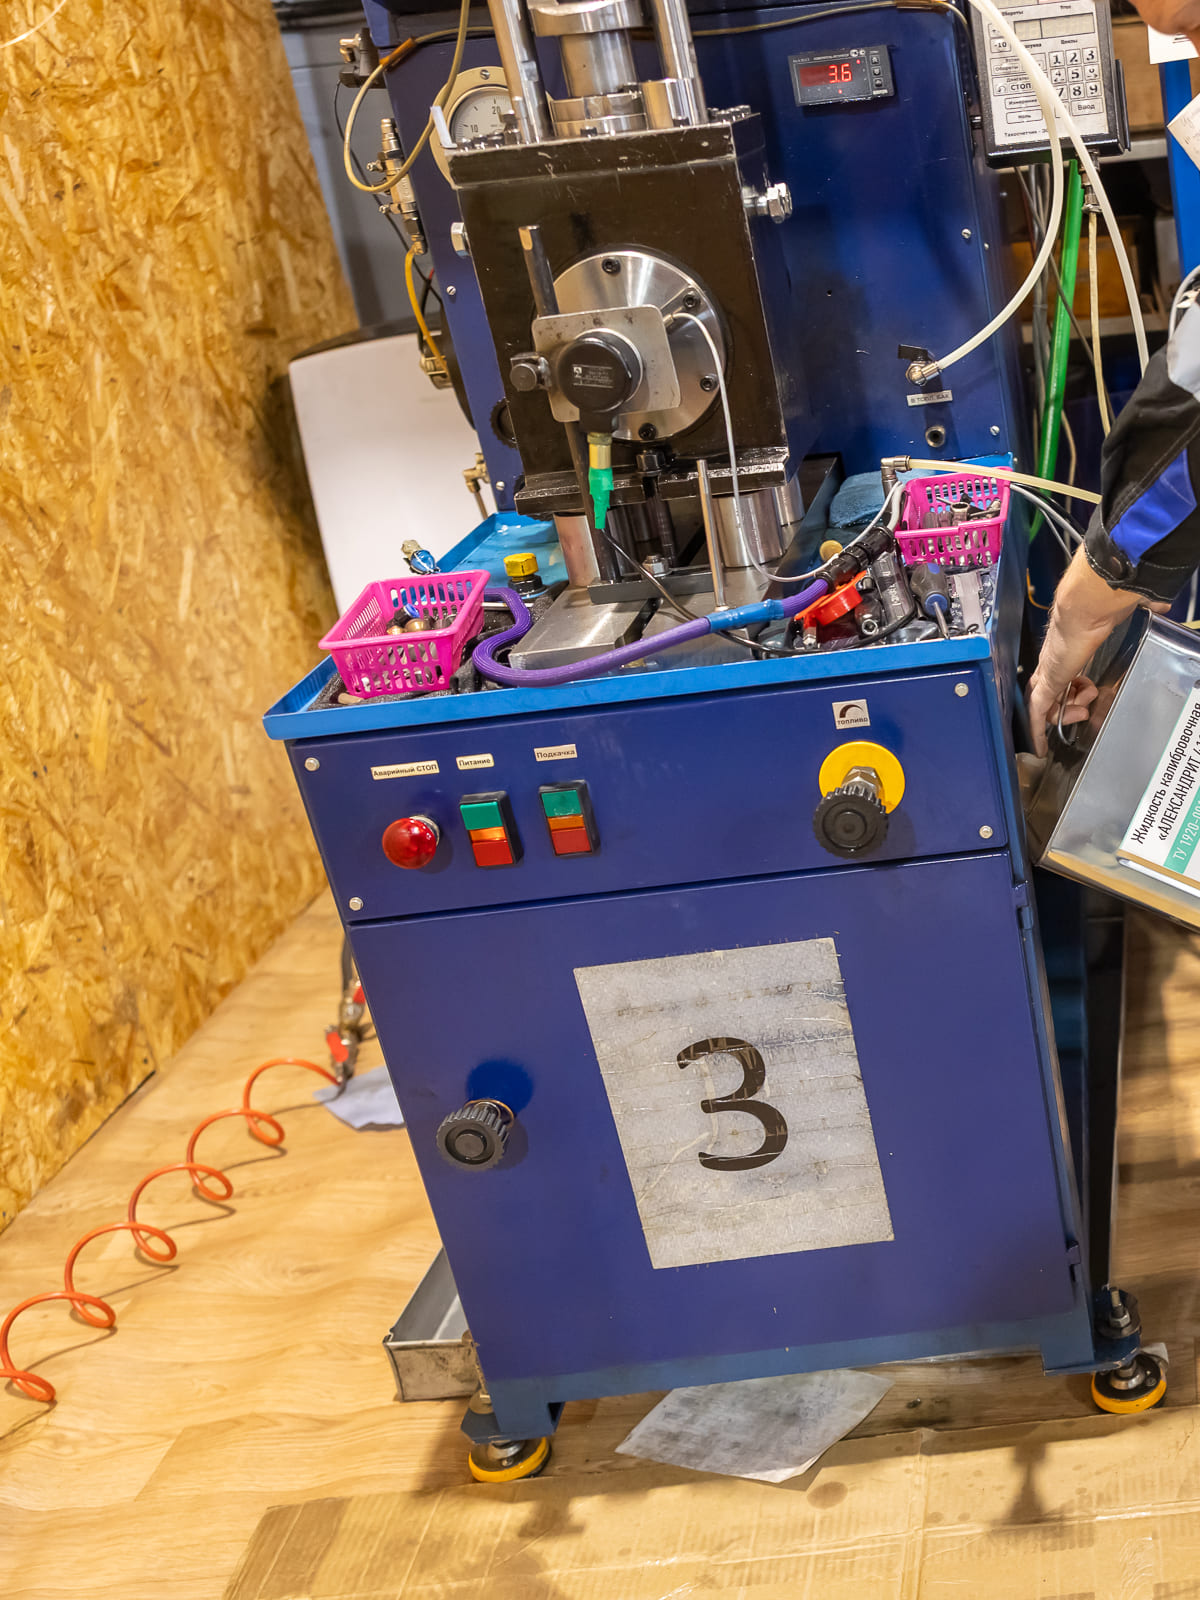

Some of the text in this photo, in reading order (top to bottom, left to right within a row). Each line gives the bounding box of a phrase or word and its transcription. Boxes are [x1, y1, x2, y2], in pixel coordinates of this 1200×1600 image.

[1053, 50, 1095, 65] 1 2 3
[829, 63, 852, 84] 3.6
[1071, 69, 1080, 80] 5
[1057, 84, 1098, 97] 7 8 9
[492, 105, 501, 115] 20
[470, 124, 479, 133] 10
[536, 750, 575, 758] Подкачка
[459, 758, 491, 766] Питание
[373, 767, 415, 776] Аварийный
[1157, 755, 1200, 840] «АЛЕКСАНДРИТ
[1130, 789, 1166, 844] Жидкость
[1172, 846, 1186, 860] ТУ
[676, 1036, 789, 1172] 3
